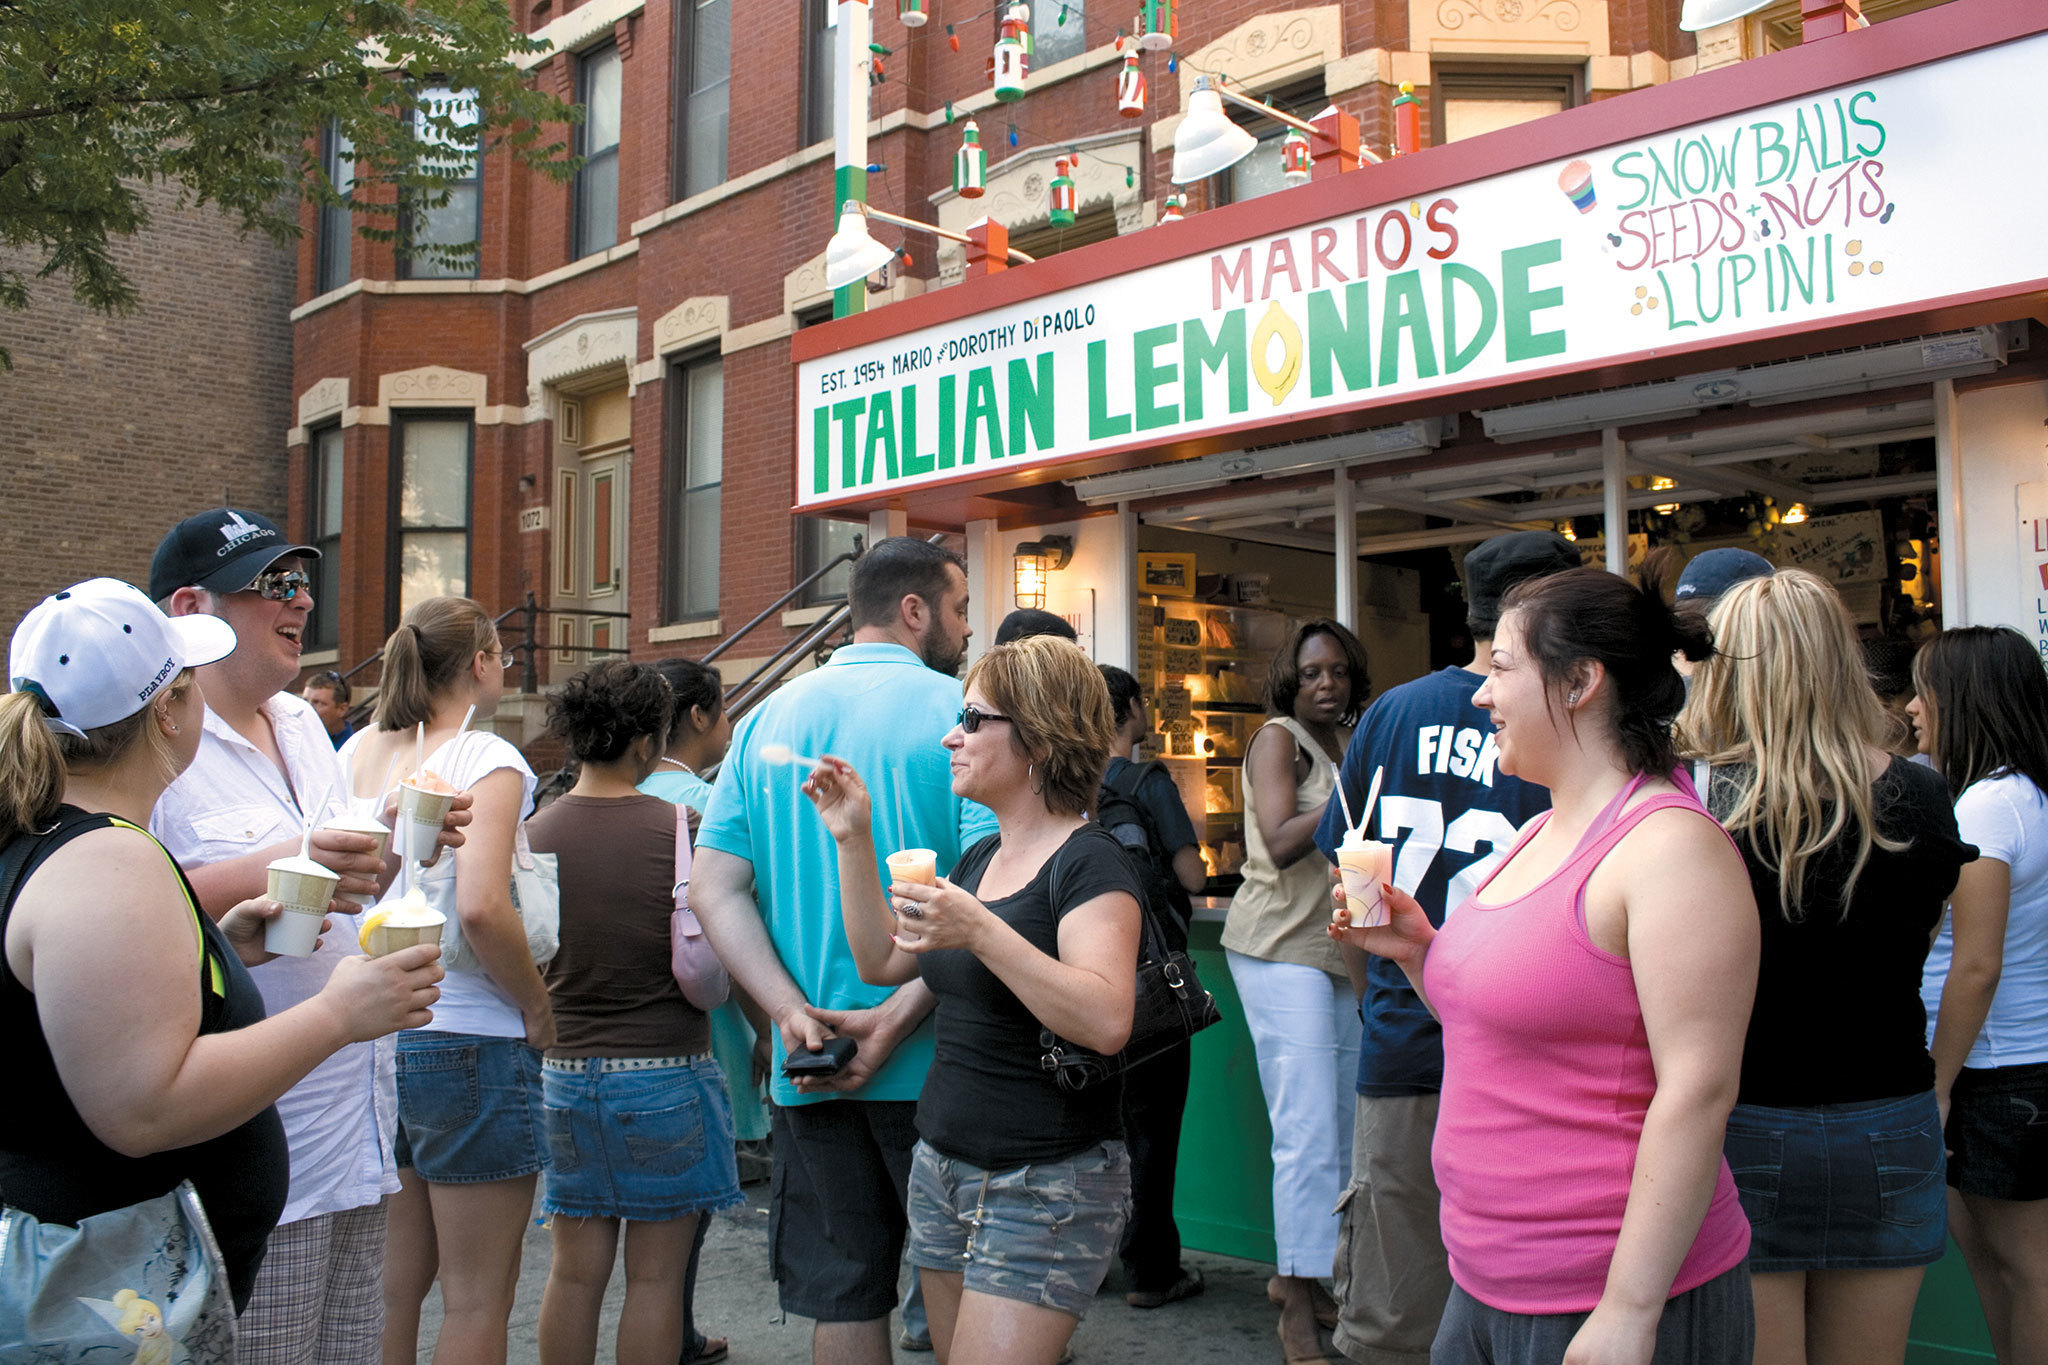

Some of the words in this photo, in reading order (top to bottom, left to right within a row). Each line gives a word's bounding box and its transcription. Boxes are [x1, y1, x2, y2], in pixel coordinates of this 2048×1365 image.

[1211, 198, 1459, 311] MARIO'S
[1616, 192, 1746, 270] SEEDS
[1760, 160, 1885, 240] NUTS
[1657, 233, 1835, 331] LUPINI
[813, 351, 1055, 494] ITALIAN
[1087, 238, 1567, 441] LEMONADE
[821, 370, 847, 394] EST.
[854, 360, 886, 388] 1954
[893, 346, 932, 376] MARIO
[949, 324, 1017, 361] DOROTHY
[1043, 304, 1096, 338] PAOLO
[217, 529, 276, 557] CHICAGO
[521, 510, 541, 529] 1072
[139, 657, 176, 702] PLAYBOY
